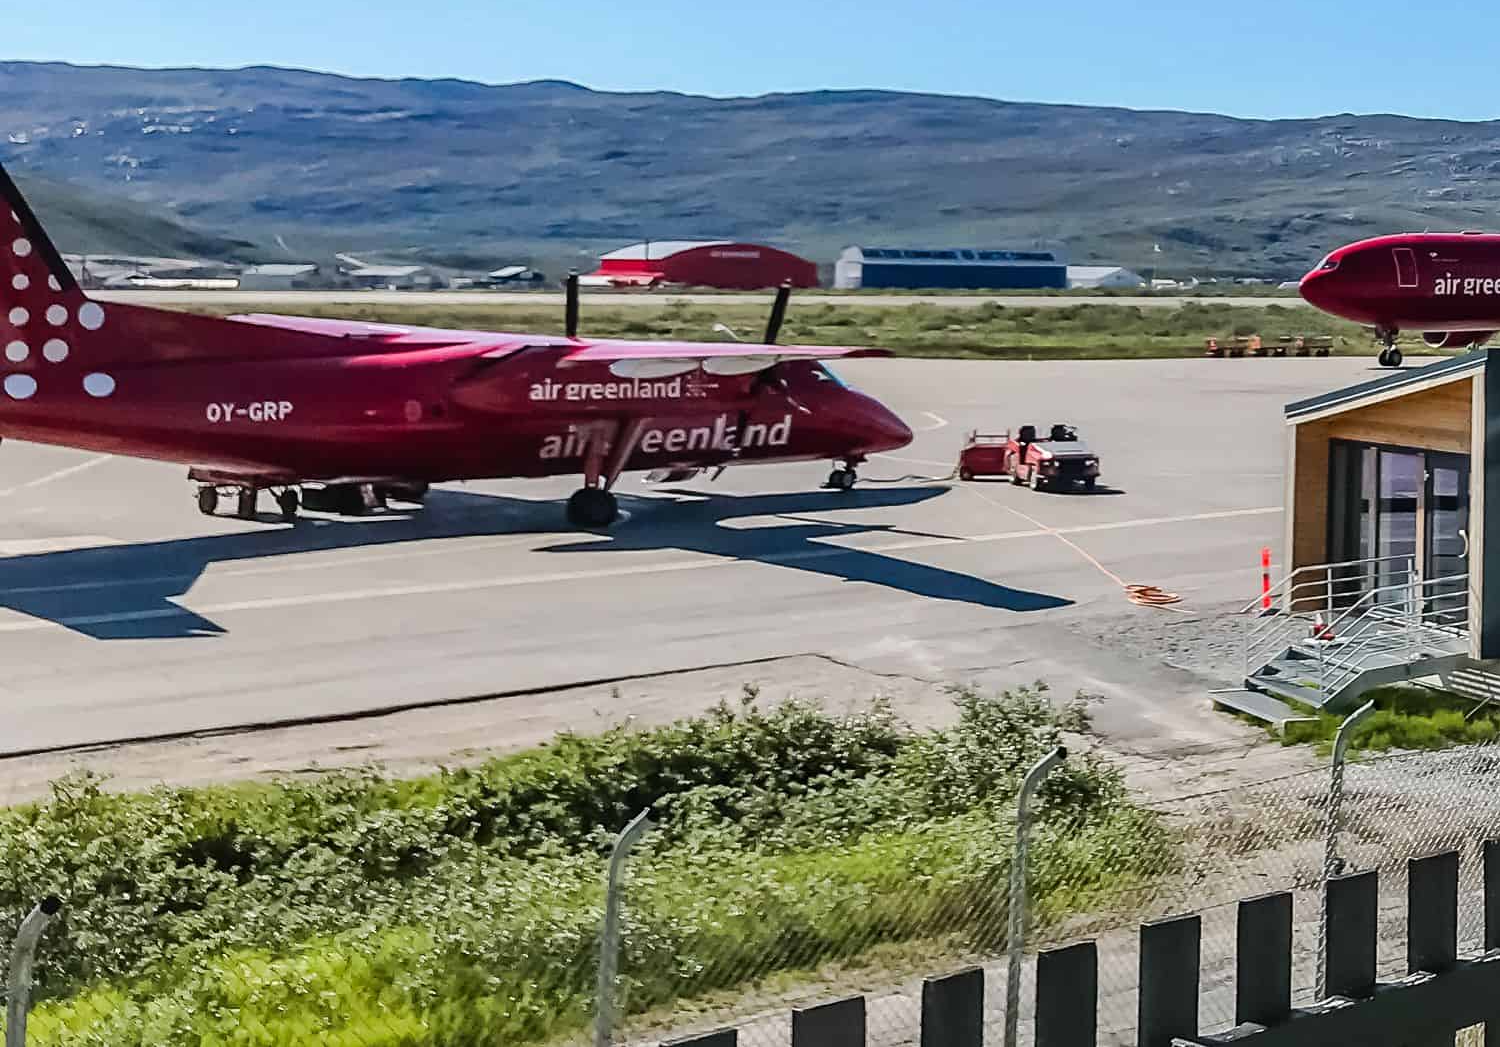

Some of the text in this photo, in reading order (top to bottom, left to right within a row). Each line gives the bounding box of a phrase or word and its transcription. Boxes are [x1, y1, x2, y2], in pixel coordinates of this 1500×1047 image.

[1434, 272, 1461, 295] air
[529, 378, 562, 400] air
[565, 377, 681, 400] greenland
[206, 401, 293, 424] OY-GRP
